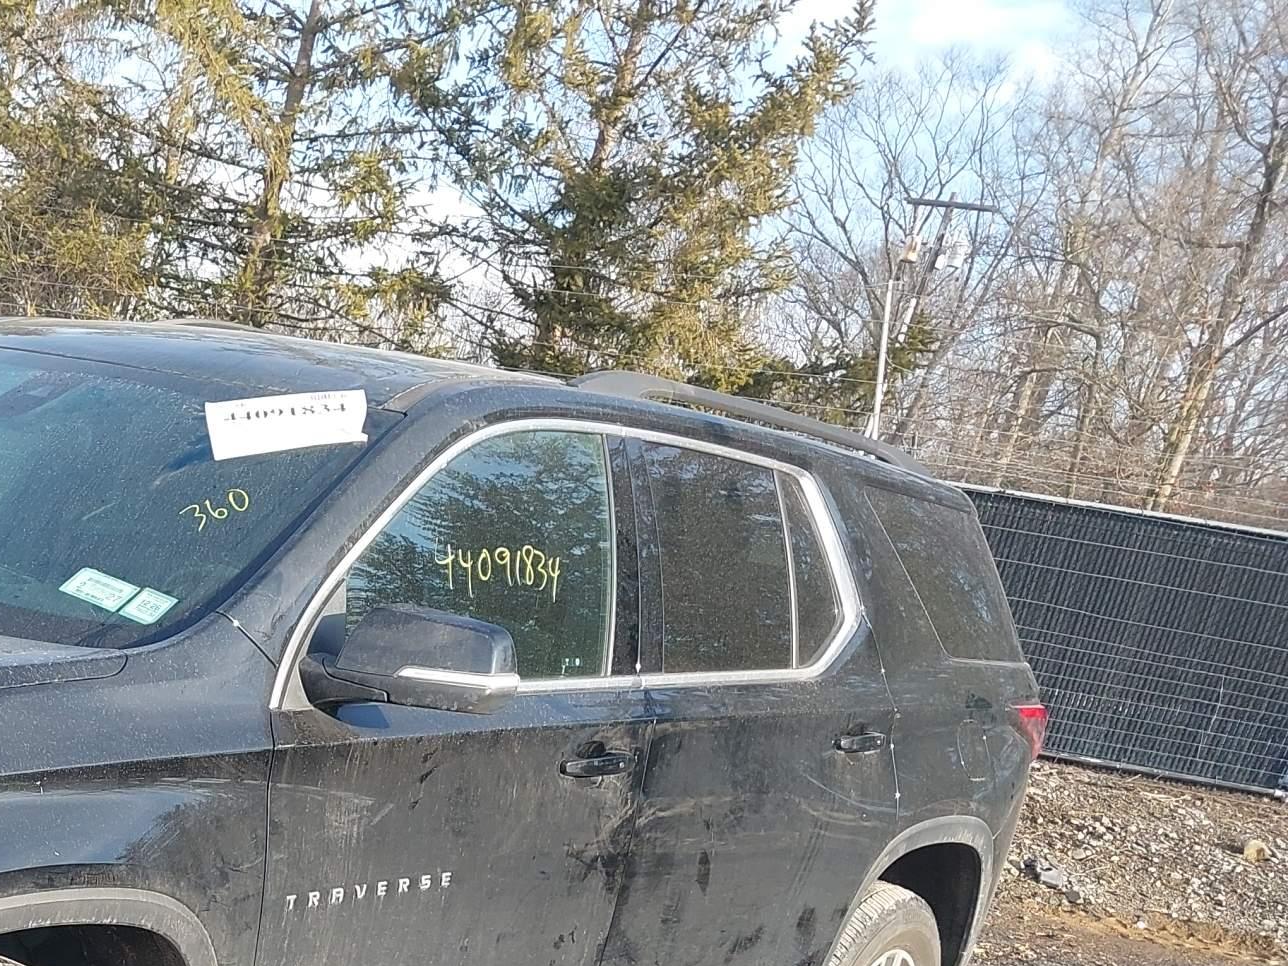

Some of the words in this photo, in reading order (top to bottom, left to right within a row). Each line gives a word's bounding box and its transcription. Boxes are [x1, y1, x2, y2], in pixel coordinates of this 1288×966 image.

[178, 487, 250, 532] 360
[434, 537, 561, 603] 44091834
[285, 871, 453, 911] TRAVERSE
